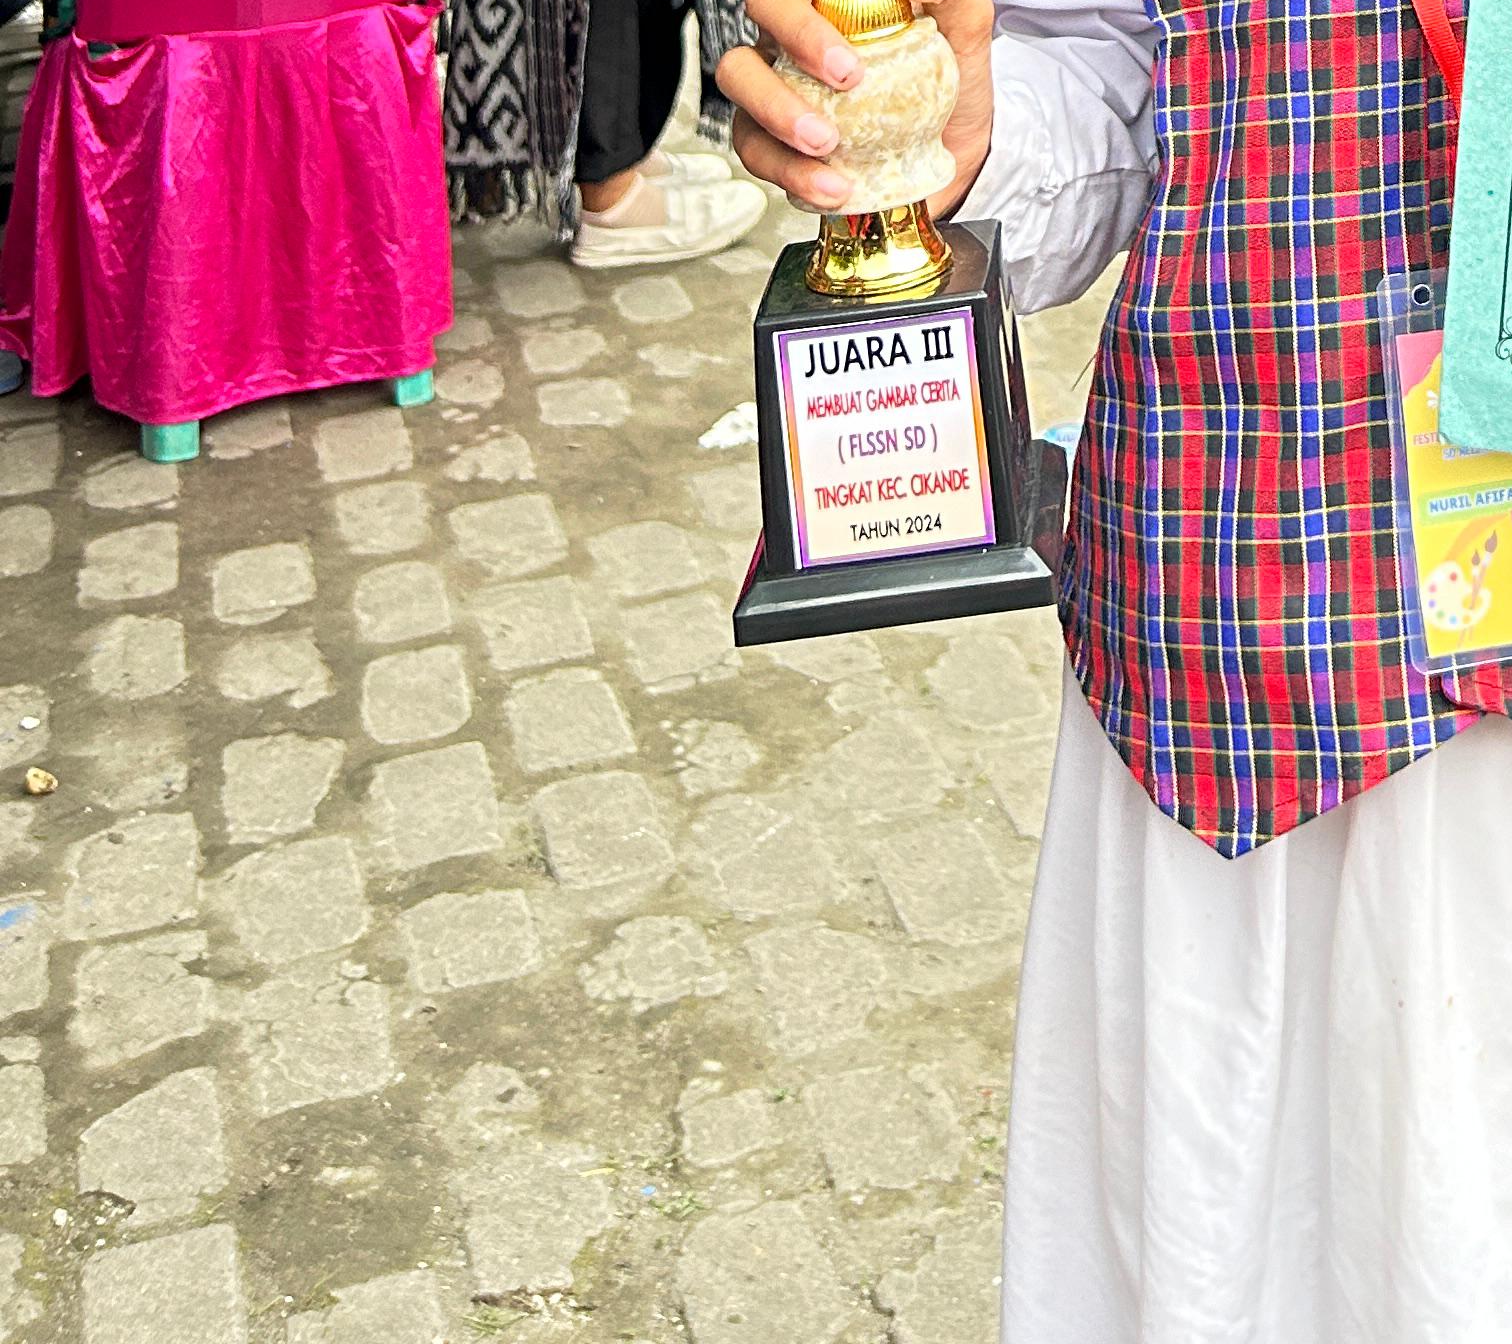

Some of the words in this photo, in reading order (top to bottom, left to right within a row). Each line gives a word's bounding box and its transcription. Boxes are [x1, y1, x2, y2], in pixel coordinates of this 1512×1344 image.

[805, 333, 911, 378] JUARA
[921, 326, 953, 362] III
[806, 390, 863, 420] MEMBUAT
[867, 384, 918, 410] GAMBAR
[921, 379, 960, 403] CERITA
[850, 429, 899, 457] FLSSN
[904, 425, 926, 452] SD
[814, 481, 873, 510] TINGKAT
[910, 468, 970, 496] CIKANDE
[1429, 491, 1473, 514] NURIL
[850, 520, 901, 542] TAHUN
[905, 513, 942, 536] 2024
